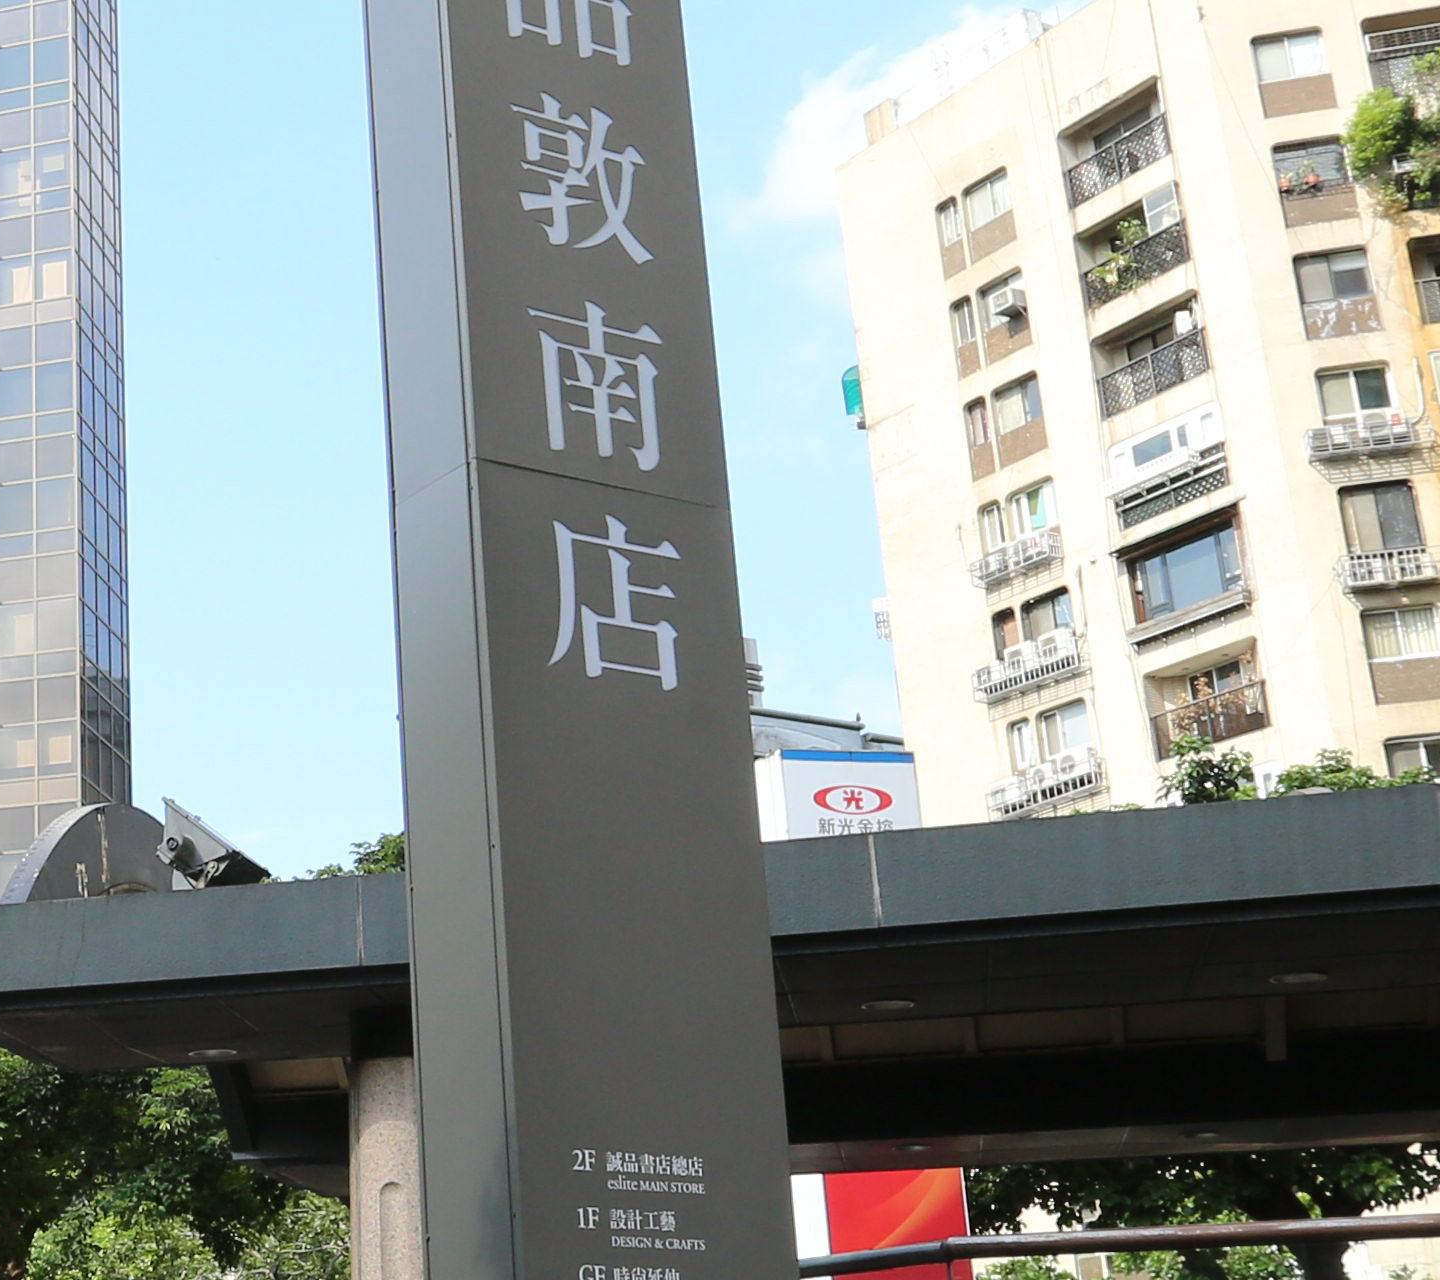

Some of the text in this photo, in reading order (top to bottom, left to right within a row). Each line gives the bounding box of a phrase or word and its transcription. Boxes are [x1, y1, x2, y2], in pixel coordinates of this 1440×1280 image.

[572, 1149, 704, 1178] 2F 誠品書店總店
[607, 1175, 707, 1195] eslite MAIN STORE
[576, 1206, 677, 1233] 1F 設計工藝
[611, 1235, 707, 1251] DESIGN & CRAFTS
